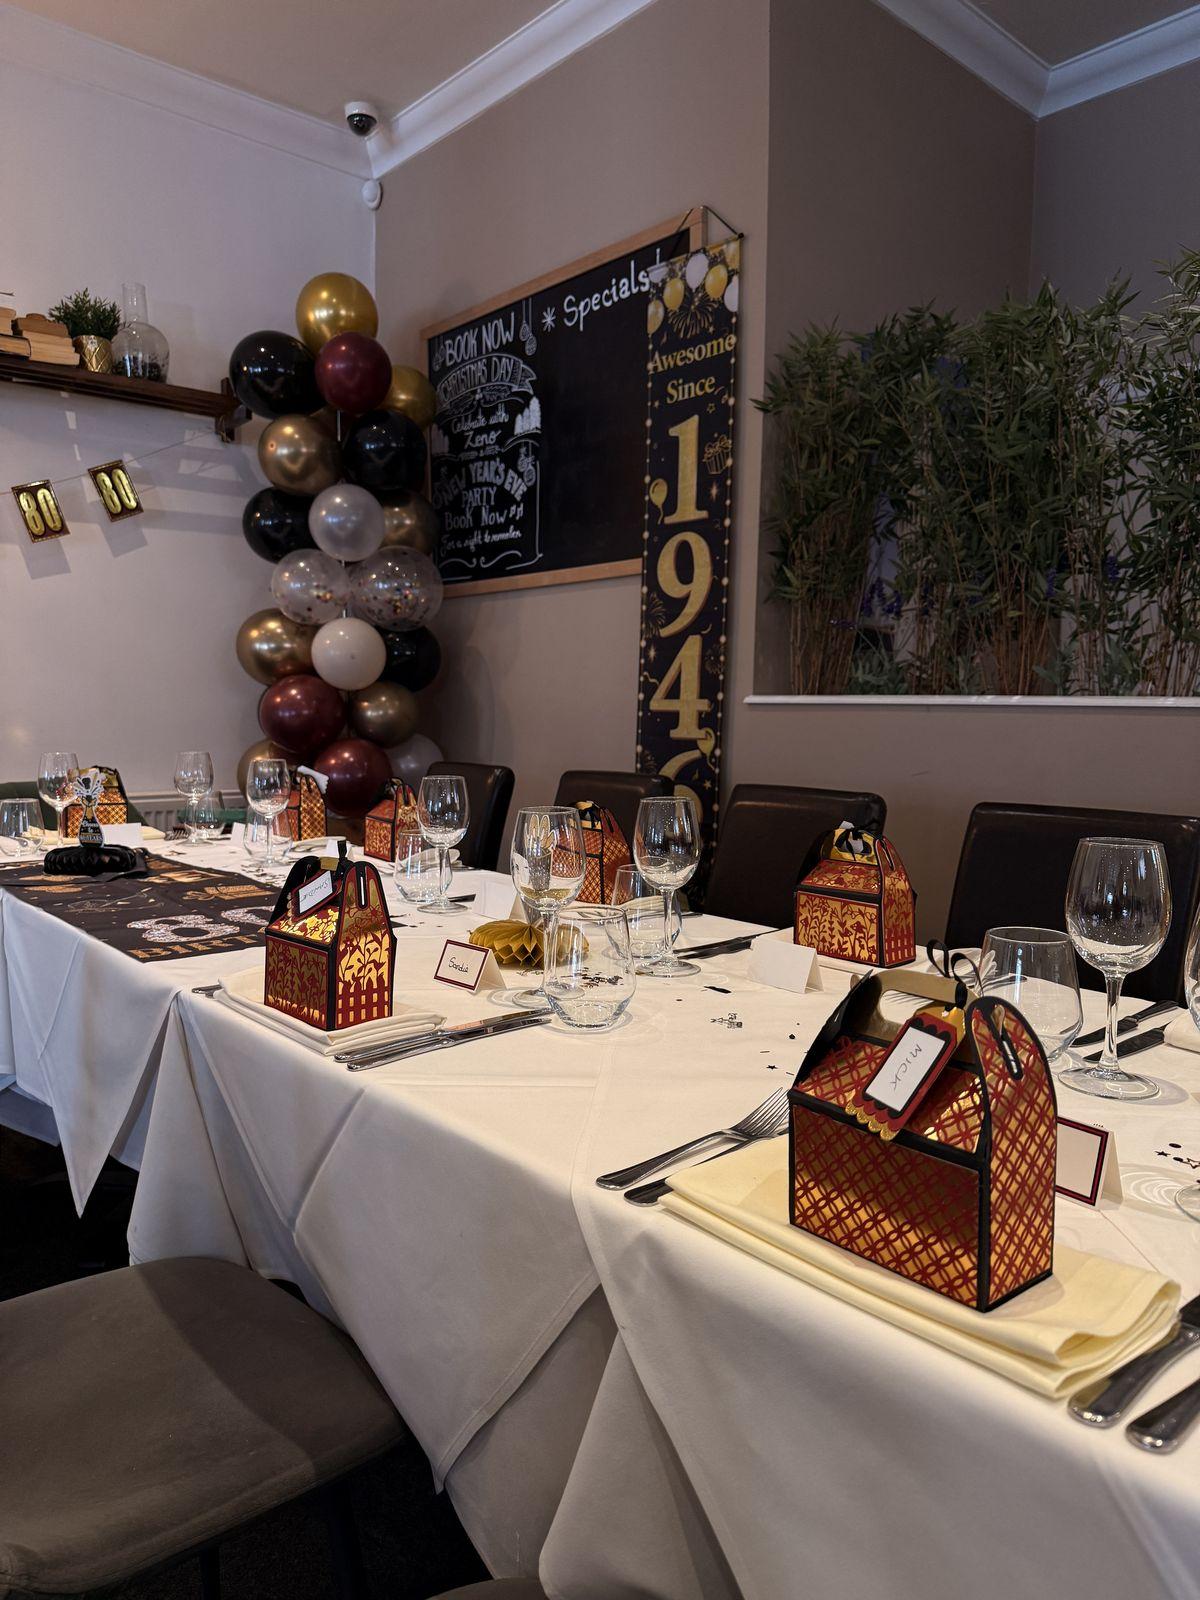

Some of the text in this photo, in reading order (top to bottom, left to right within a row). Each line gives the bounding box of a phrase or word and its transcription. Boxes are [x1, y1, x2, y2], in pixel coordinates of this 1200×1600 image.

[445, 311, 515, 367] BOOK NOW
[649, 333, 738, 375] Awesome
[441, 357, 514, 401] CHRISTMAS DAY
[665, 375, 716, 405] Since
[451, 403, 510, 434] Celebrate with
[96, 468, 138, 514] 80
[461, 486, 498, 509] PARTY
[503, 468, 528, 502] EVE
[19, 488, 63, 536] 80
[889, 1043, 923, 1092] MICK
